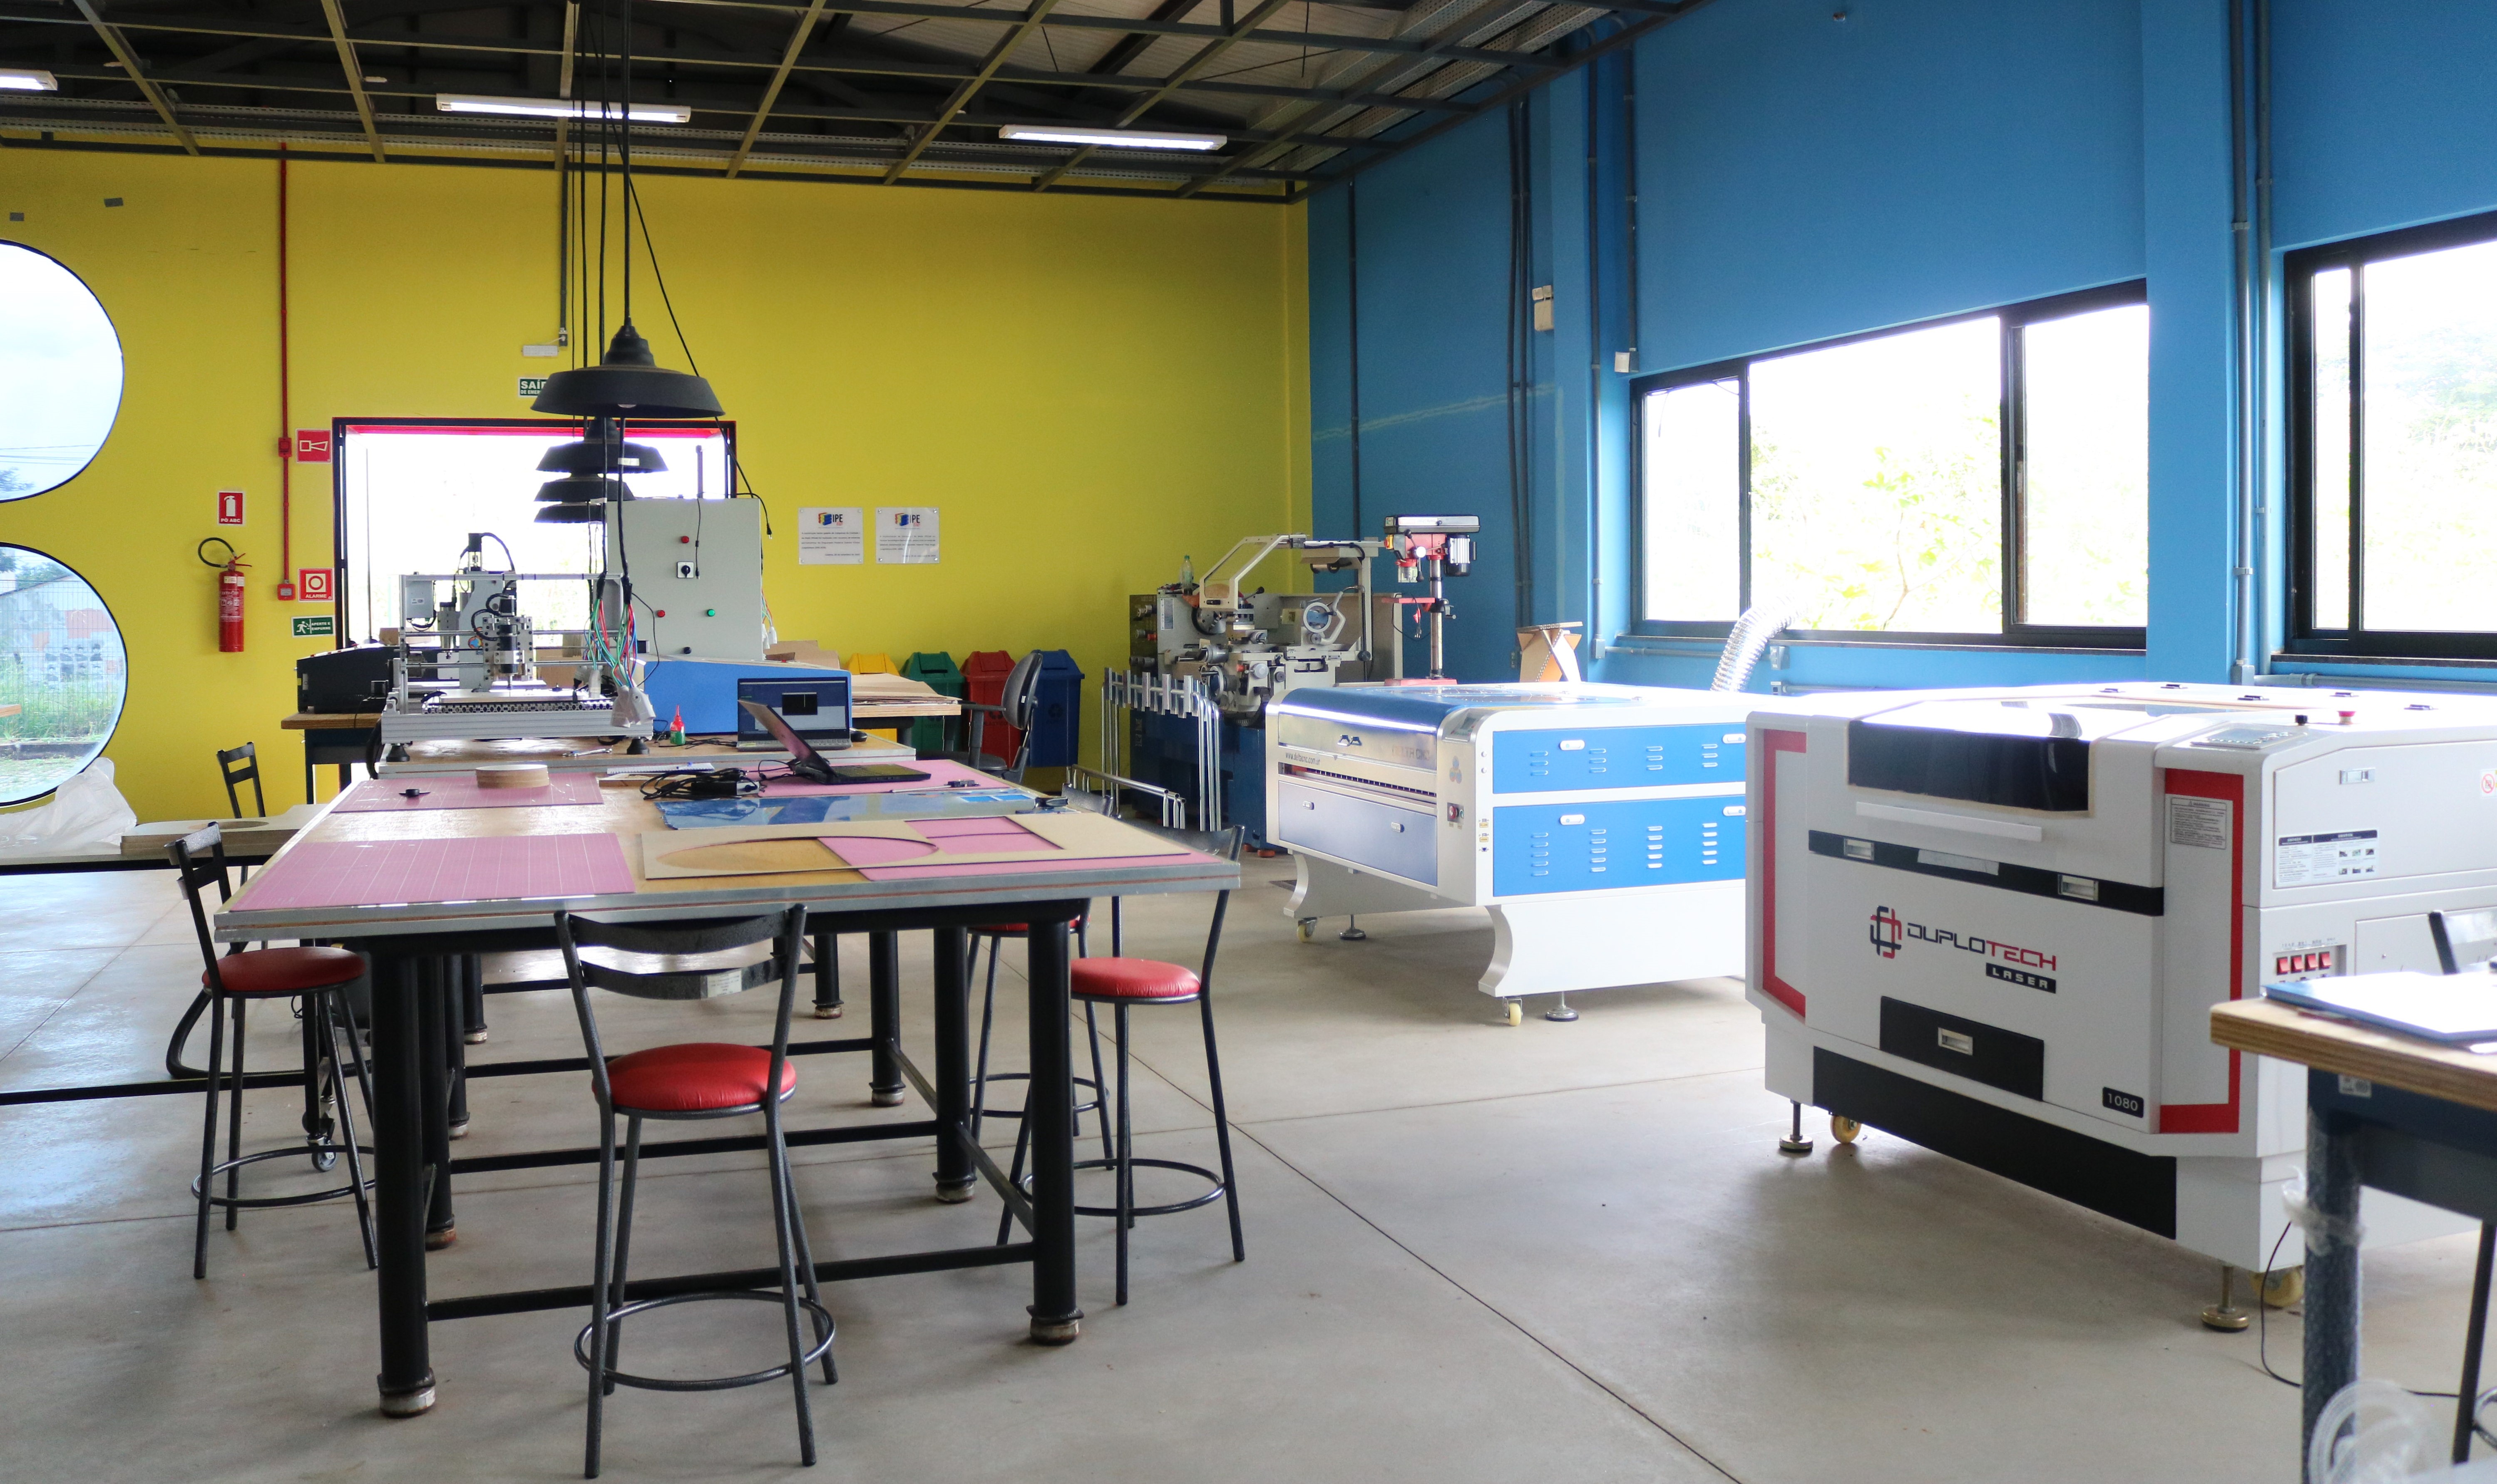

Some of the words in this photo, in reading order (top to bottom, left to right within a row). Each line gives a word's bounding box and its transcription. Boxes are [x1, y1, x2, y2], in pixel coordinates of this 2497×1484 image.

[832, 514, 843, 522] IPE
[909, 514, 920, 523] IPE
[1908, 922, 2056, 971] DUPLOTECH
[1992, 967, 2048, 989] LASER
[2108, 1093, 2138, 1112] 1080
